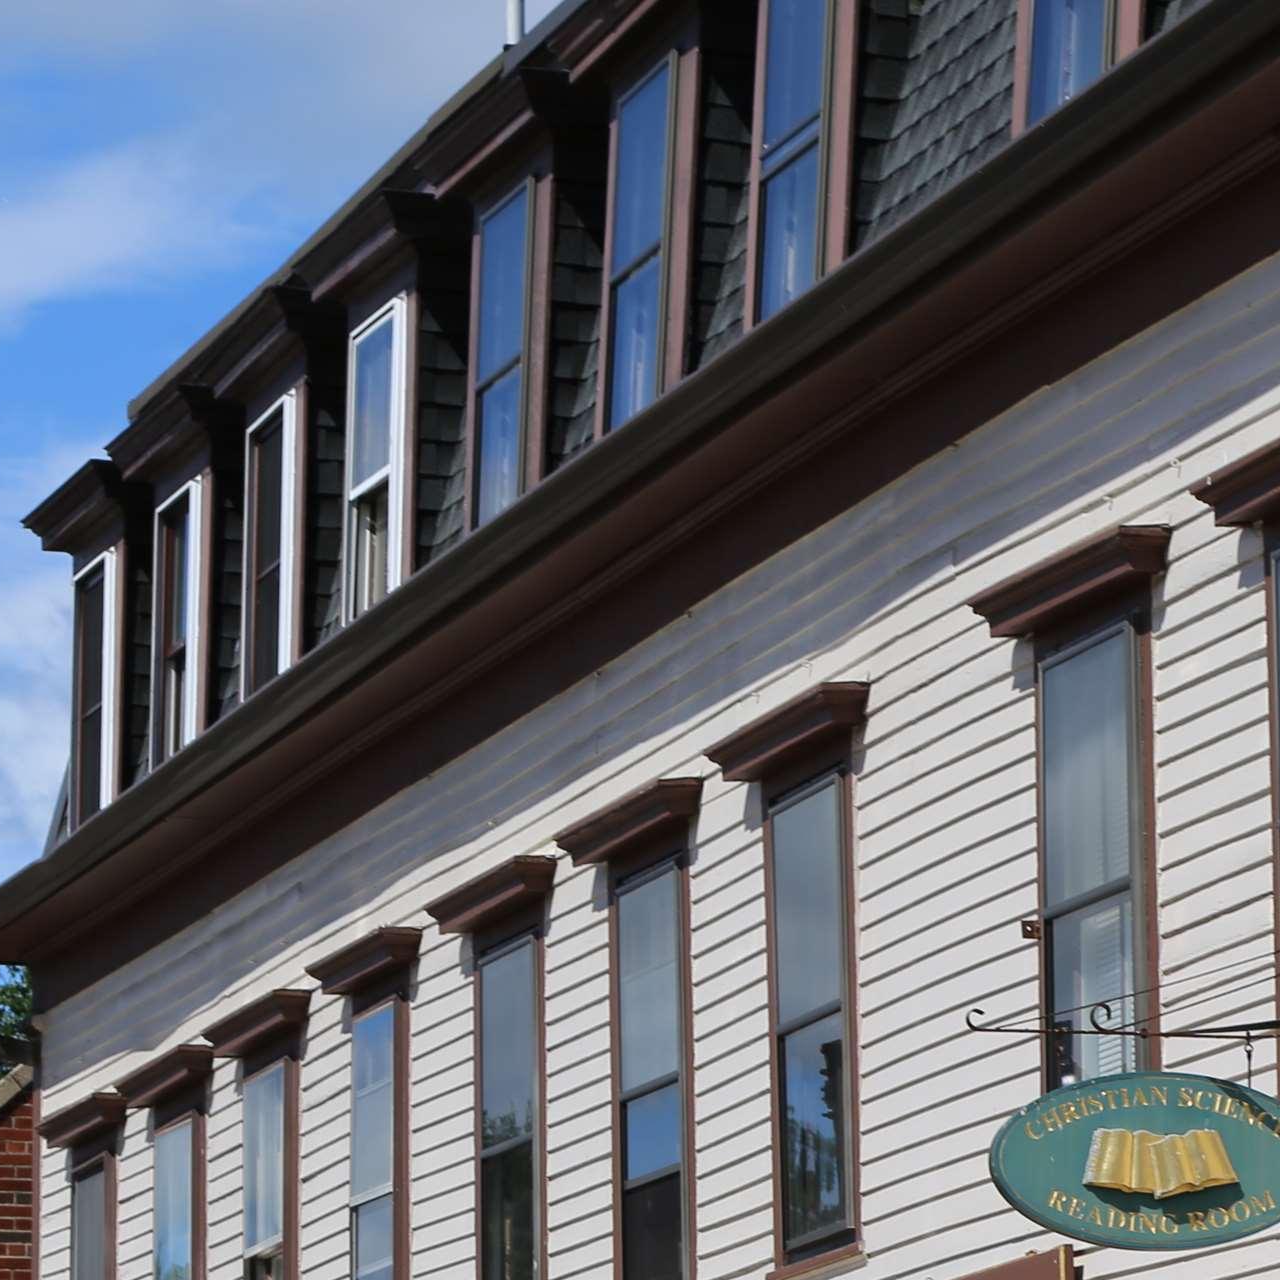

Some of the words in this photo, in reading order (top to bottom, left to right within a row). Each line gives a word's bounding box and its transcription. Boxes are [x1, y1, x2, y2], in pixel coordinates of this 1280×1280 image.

[1024, 1086, 1169, 1141] CHRISTIAN
[1047, 1188, 1179, 1235] READING
[1186, 1189, 1277, 1232] ROOM
